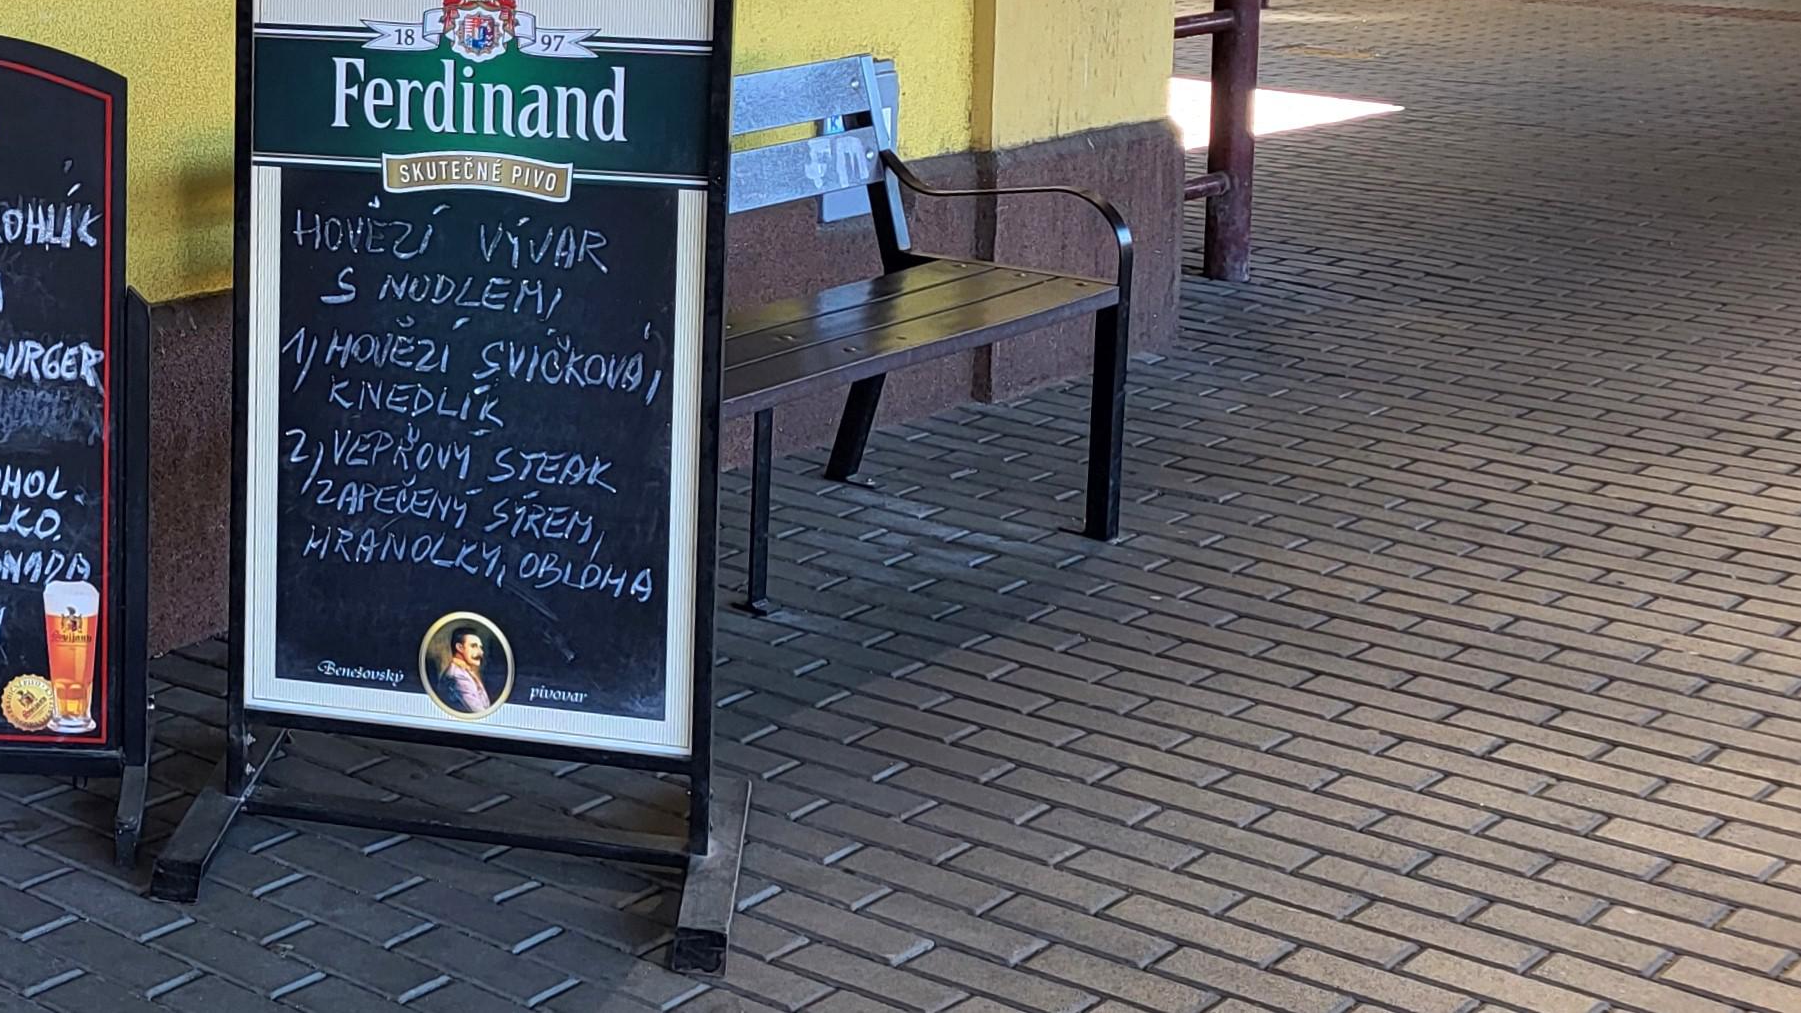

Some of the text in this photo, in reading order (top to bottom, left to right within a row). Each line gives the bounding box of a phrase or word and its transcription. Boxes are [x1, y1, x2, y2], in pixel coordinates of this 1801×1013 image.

[393, 28, 566, 52] 18 97
[330, 56, 628, 143] Ferdinand
[399, 156, 558, 192] SKUTEČNÉ PIVO
[479, 216, 609, 274] VÝVAR
[320, 267, 356, 304] S
[324, 315, 470, 374] HOVĚZÍ
[328, 374, 504, 427] KNEDLÍK
[334, 422, 491, 480] VEPŘOVÝ
[487, 446, 618, 494] STEAK
[316, 474, 483, 530] ZAPEČENÝ
[519, 551, 653, 603] OBLOHA
[317, 659, 589, 704] Benešovský pivovar
